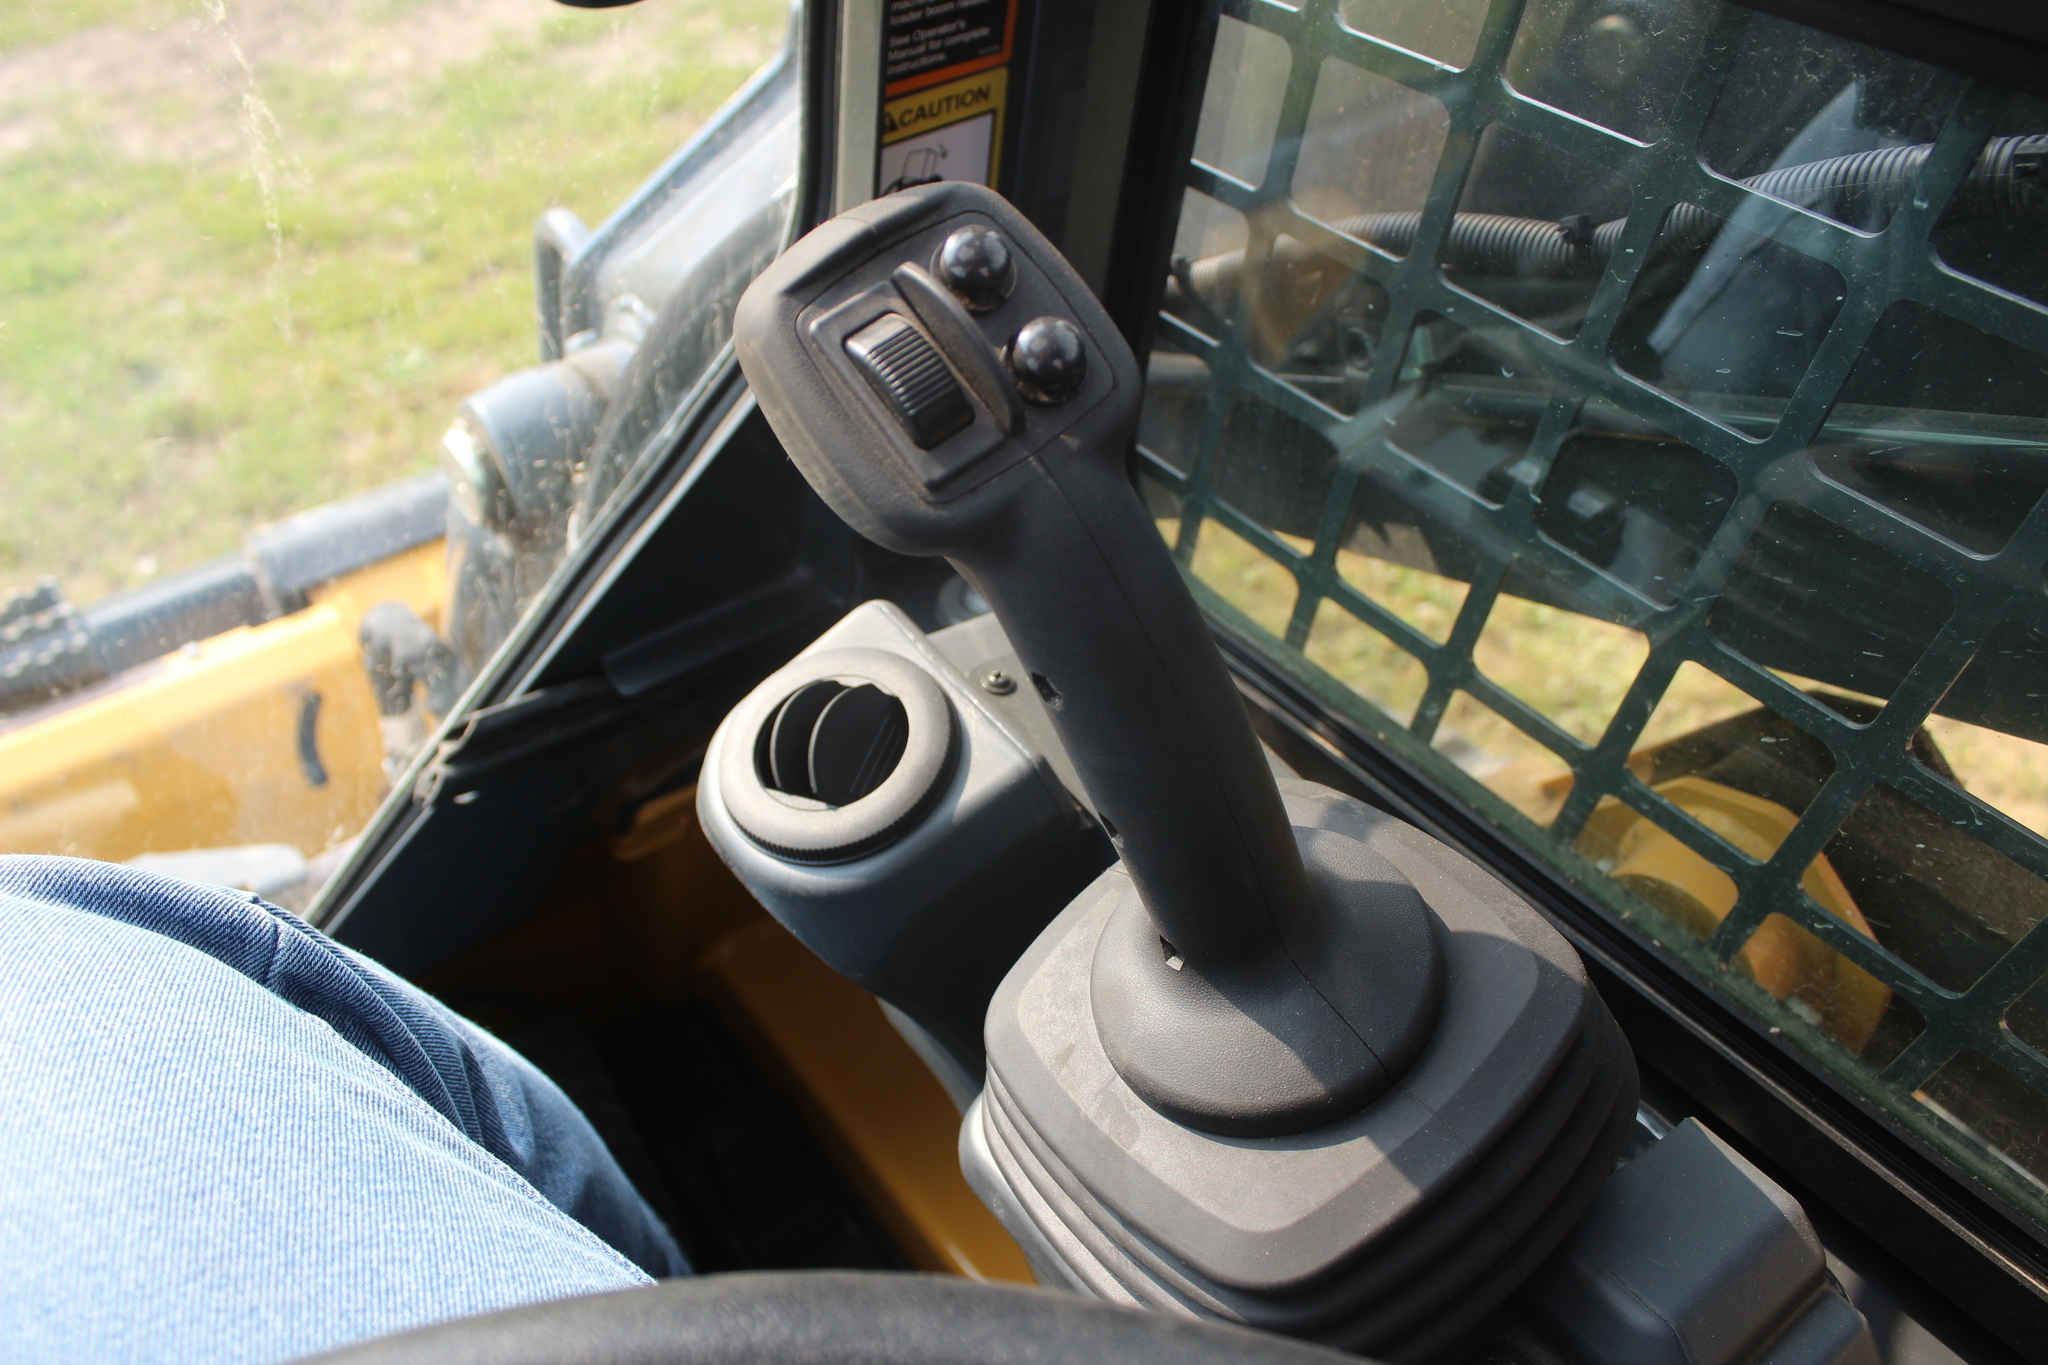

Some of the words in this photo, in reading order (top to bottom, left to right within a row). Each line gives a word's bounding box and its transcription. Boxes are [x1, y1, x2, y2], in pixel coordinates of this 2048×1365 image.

[889, 9, 924, 26] loader
[925, 1, 955, 17] boom
[887, 43, 926, 61] Manual
[928, 38, 942, 51] for
[944, 26, 991, 47] complete
[889, 35, 910, 48] See
[912, 20, 967, 41] Operator's
[899, 84, 992, 127] CAUTION
